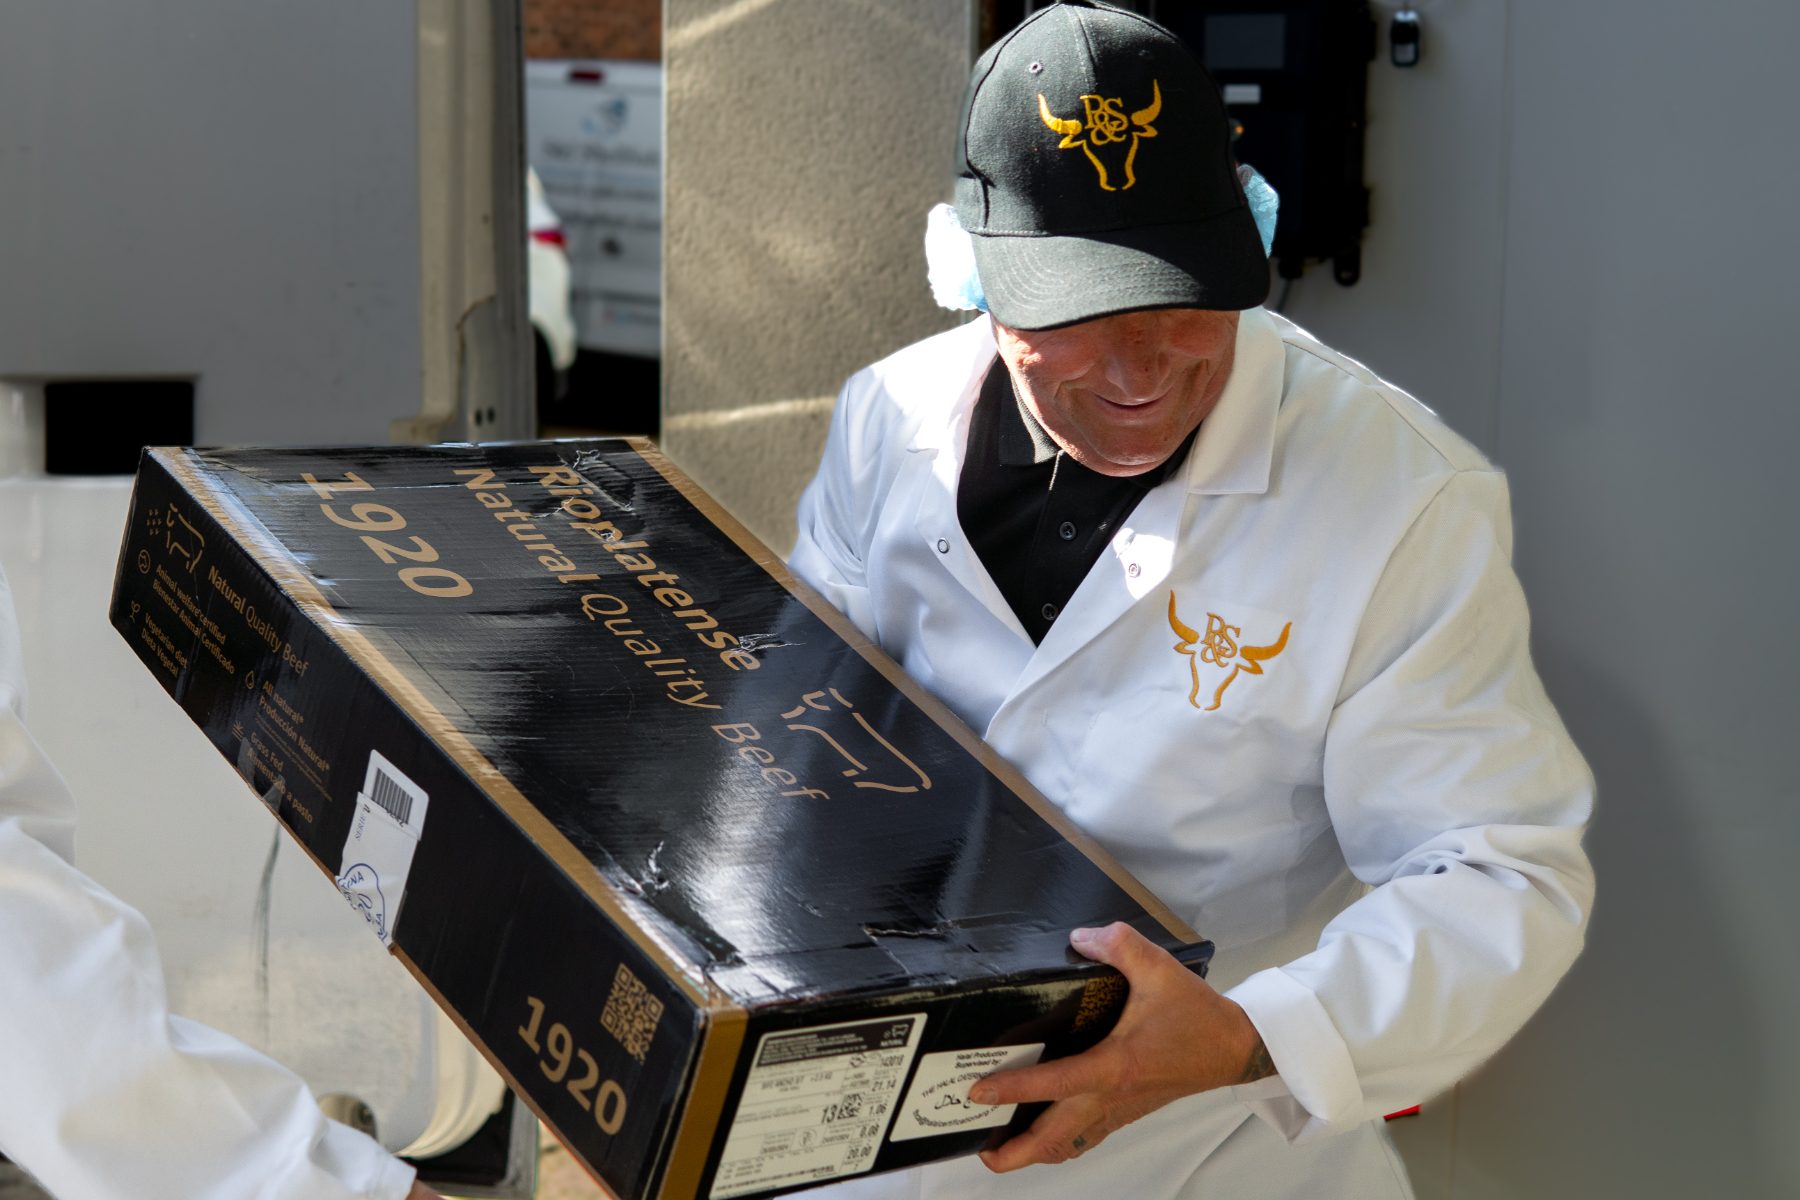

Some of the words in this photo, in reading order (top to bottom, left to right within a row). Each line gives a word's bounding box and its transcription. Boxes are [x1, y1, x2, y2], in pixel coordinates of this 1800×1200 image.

[156, 564, 178, 592] Animal
[300, 471, 474, 598] 1920
[527, 465, 761, 671] Rioplatense
[145, 612, 175, 654] Vegetarian
[179, 609, 202, 638] Animal
[201, 633, 236, 675] Certificado
[208, 565, 246, 614] Natural
[246, 605, 282, 653] Quality
[282, 642, 309, 677] Beef
[453, 468, 601, 584] Natural
[580, 593, 723, 710] Quality
[711, 722, 831, 800] Beef
[270, 752, 284, 772] Fed
[518, 996, 627, 1136] 1920
